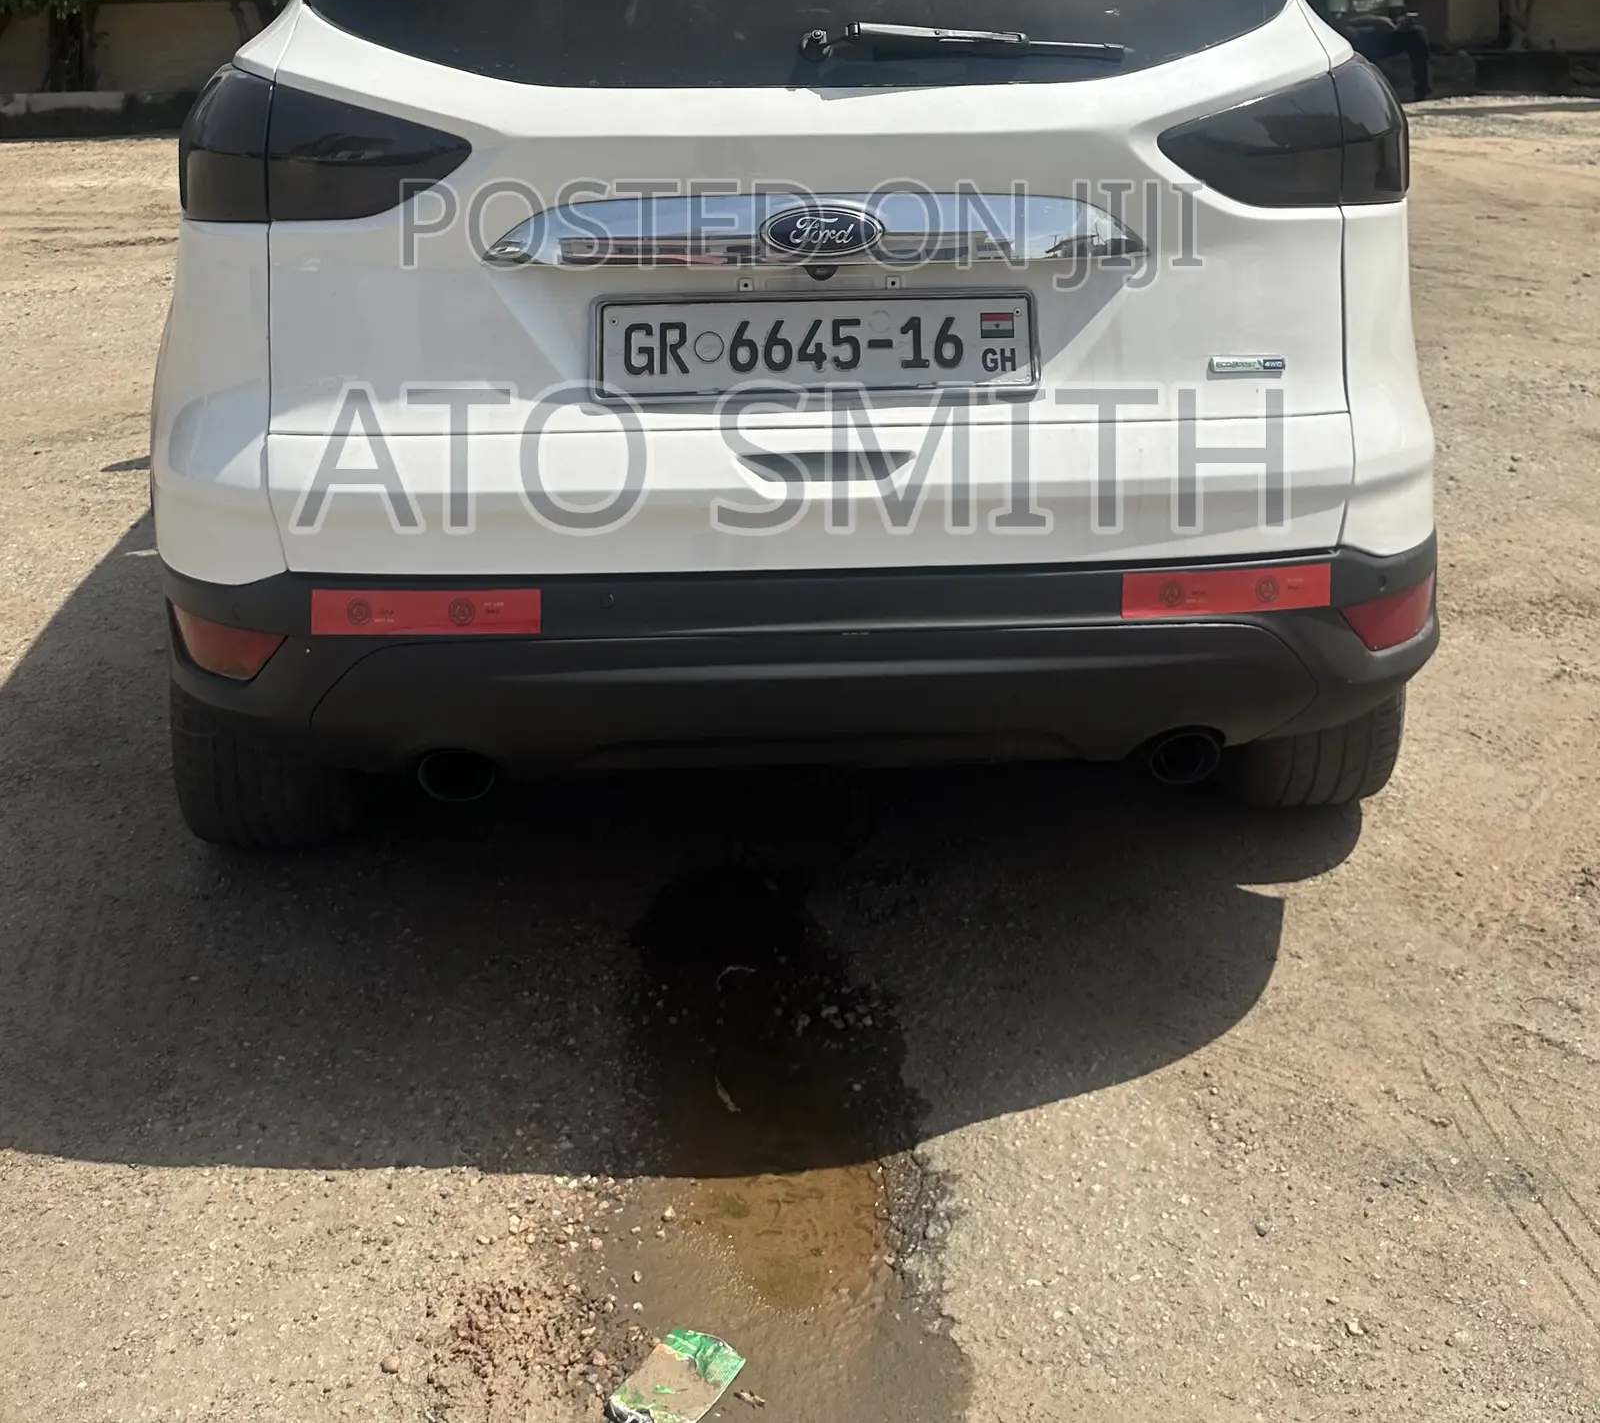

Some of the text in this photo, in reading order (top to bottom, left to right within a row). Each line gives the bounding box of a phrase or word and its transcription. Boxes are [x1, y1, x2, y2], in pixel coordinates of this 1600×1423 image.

[789, 216, 855, 244] Ford
[623, 316, 965, 376] GR 6645-16
[981, 347, 1017, 373] GH
